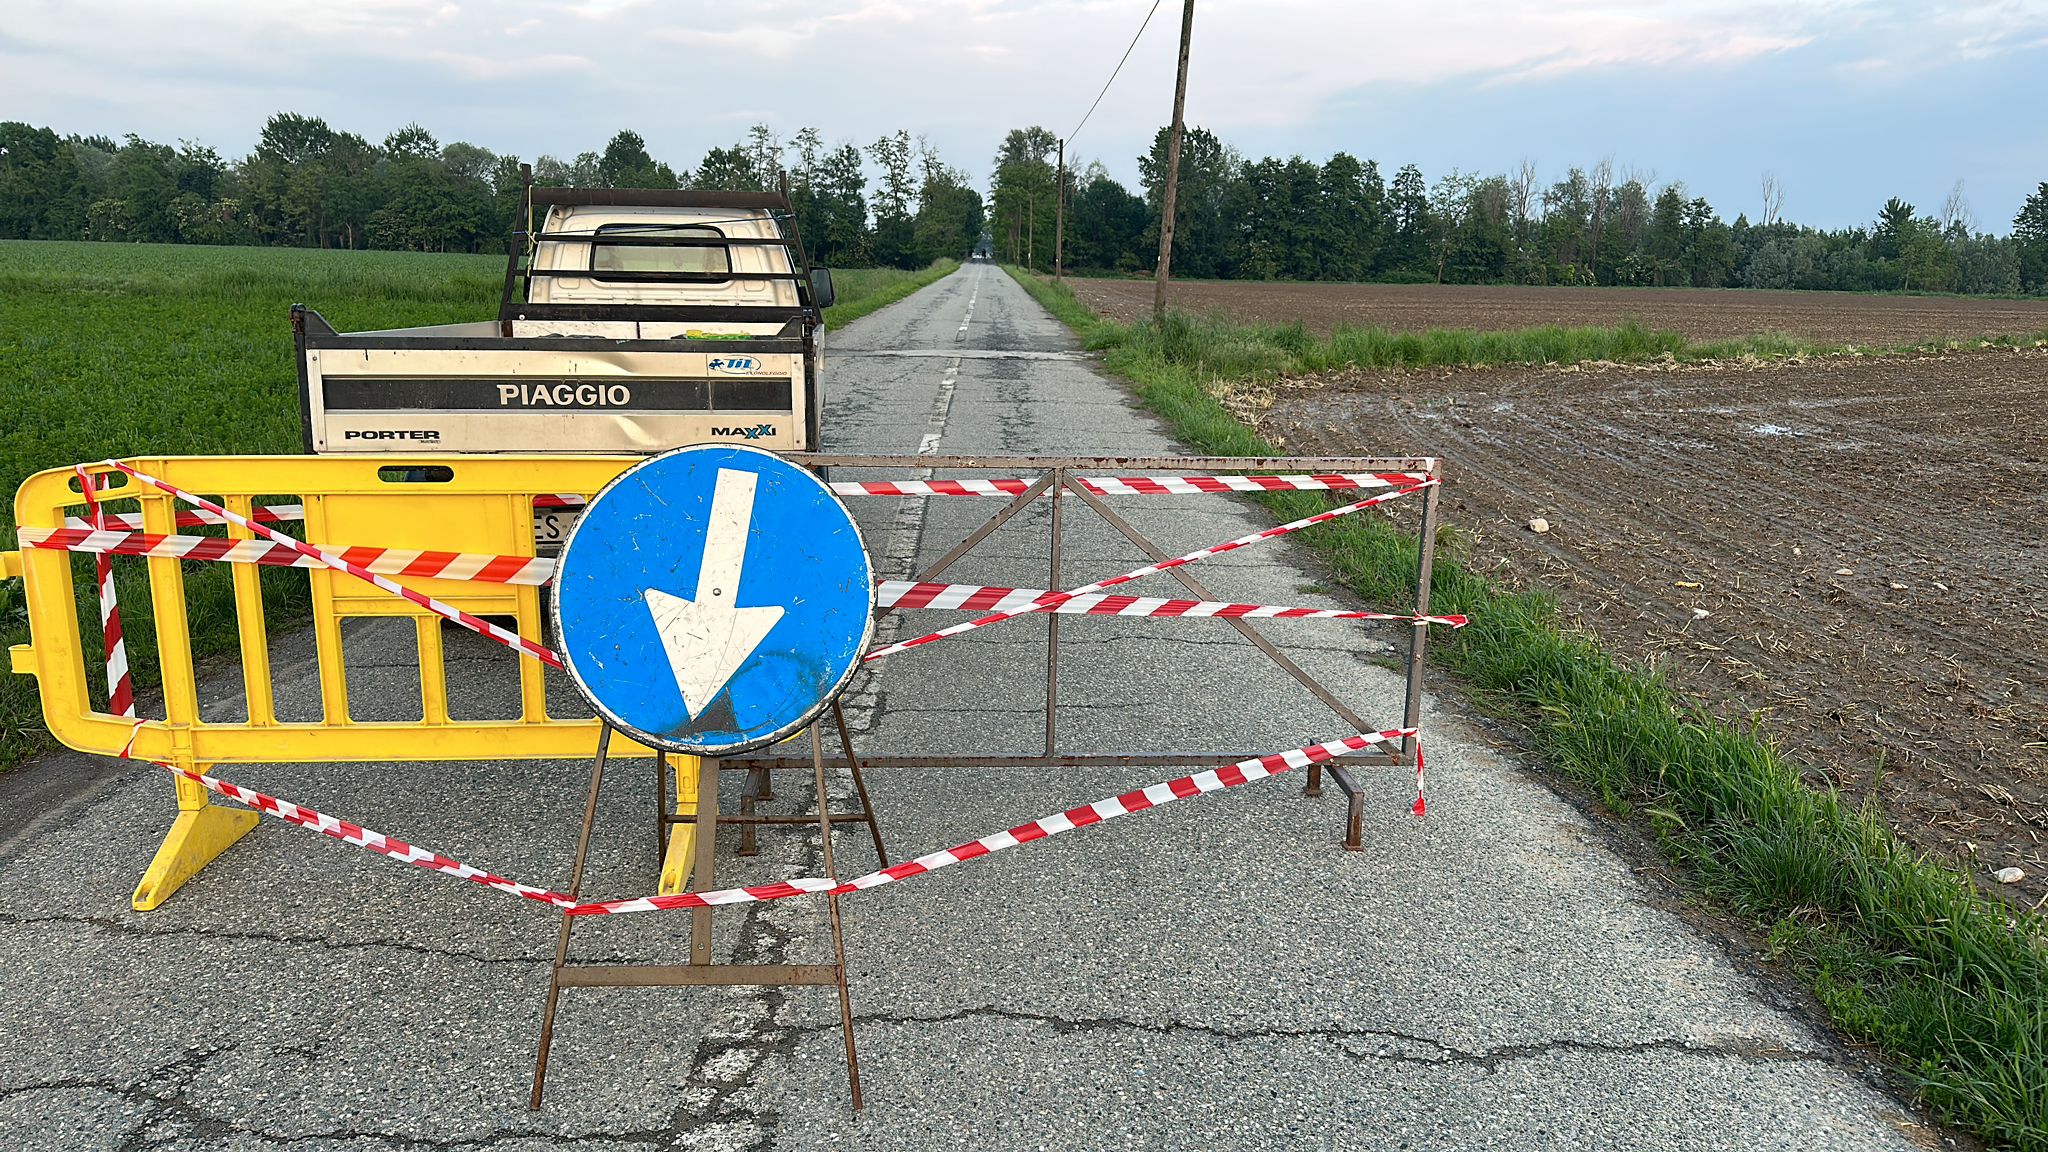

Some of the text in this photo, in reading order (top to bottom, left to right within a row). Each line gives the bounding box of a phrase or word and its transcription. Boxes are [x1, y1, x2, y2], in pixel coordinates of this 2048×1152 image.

[497, 384, 630, 406] PIAGGIO
[344, 430, 440, 440] PORTER
[711, 424, 776, 439] MAXXI
